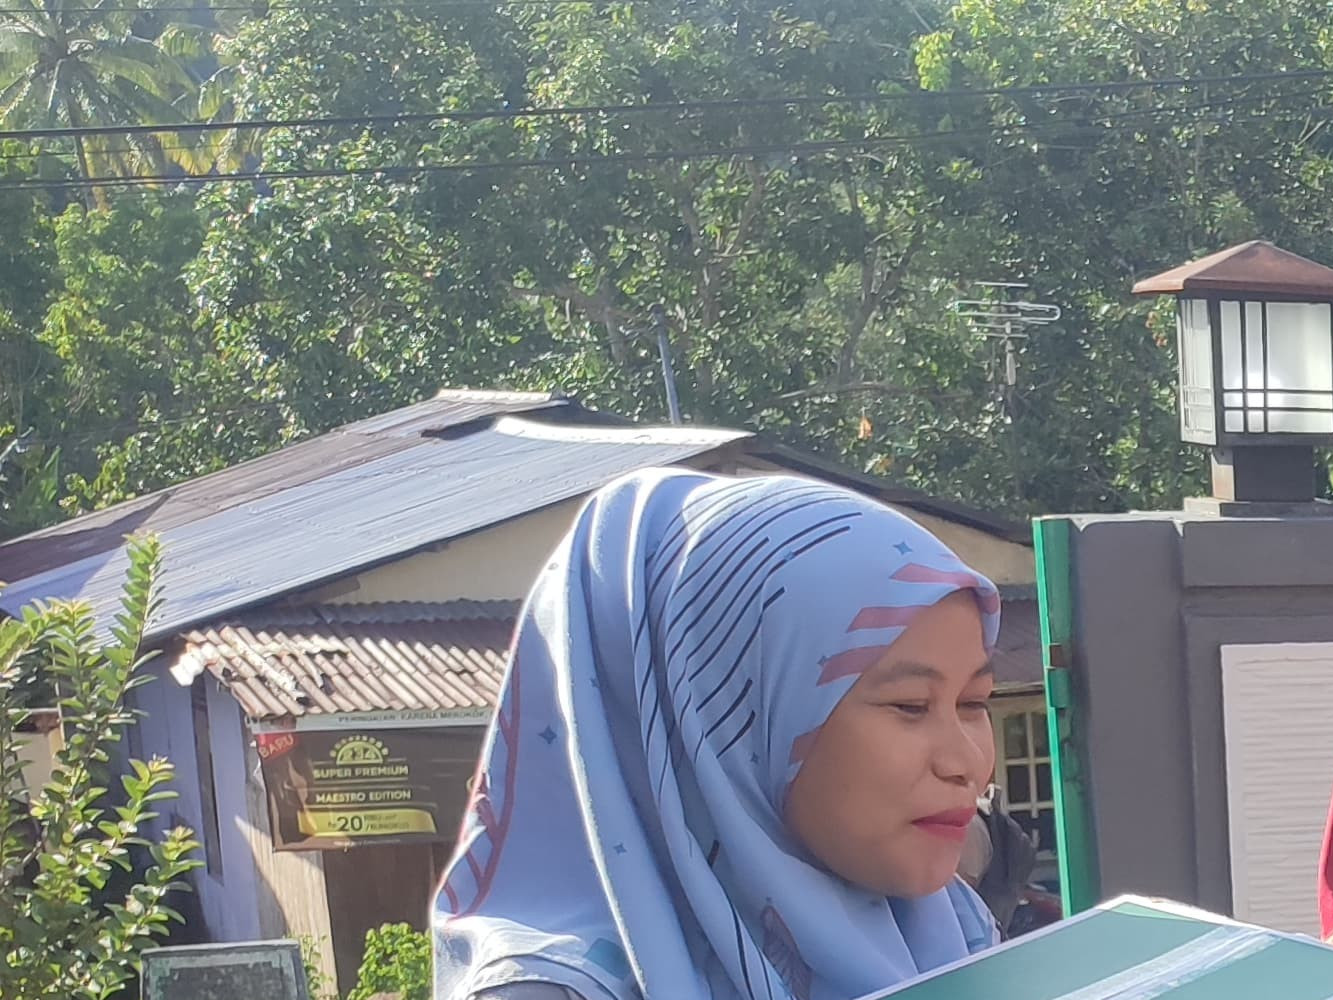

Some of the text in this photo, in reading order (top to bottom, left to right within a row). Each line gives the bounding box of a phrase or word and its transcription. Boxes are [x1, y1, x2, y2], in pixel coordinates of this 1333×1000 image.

[258, 733, 294, 758] BARU
[313, 764, 409, 779] SUPER PREMIUM
[315, 789, 412, 803] MAESTRO EDITION
[336, 815, 363, 832] 20
